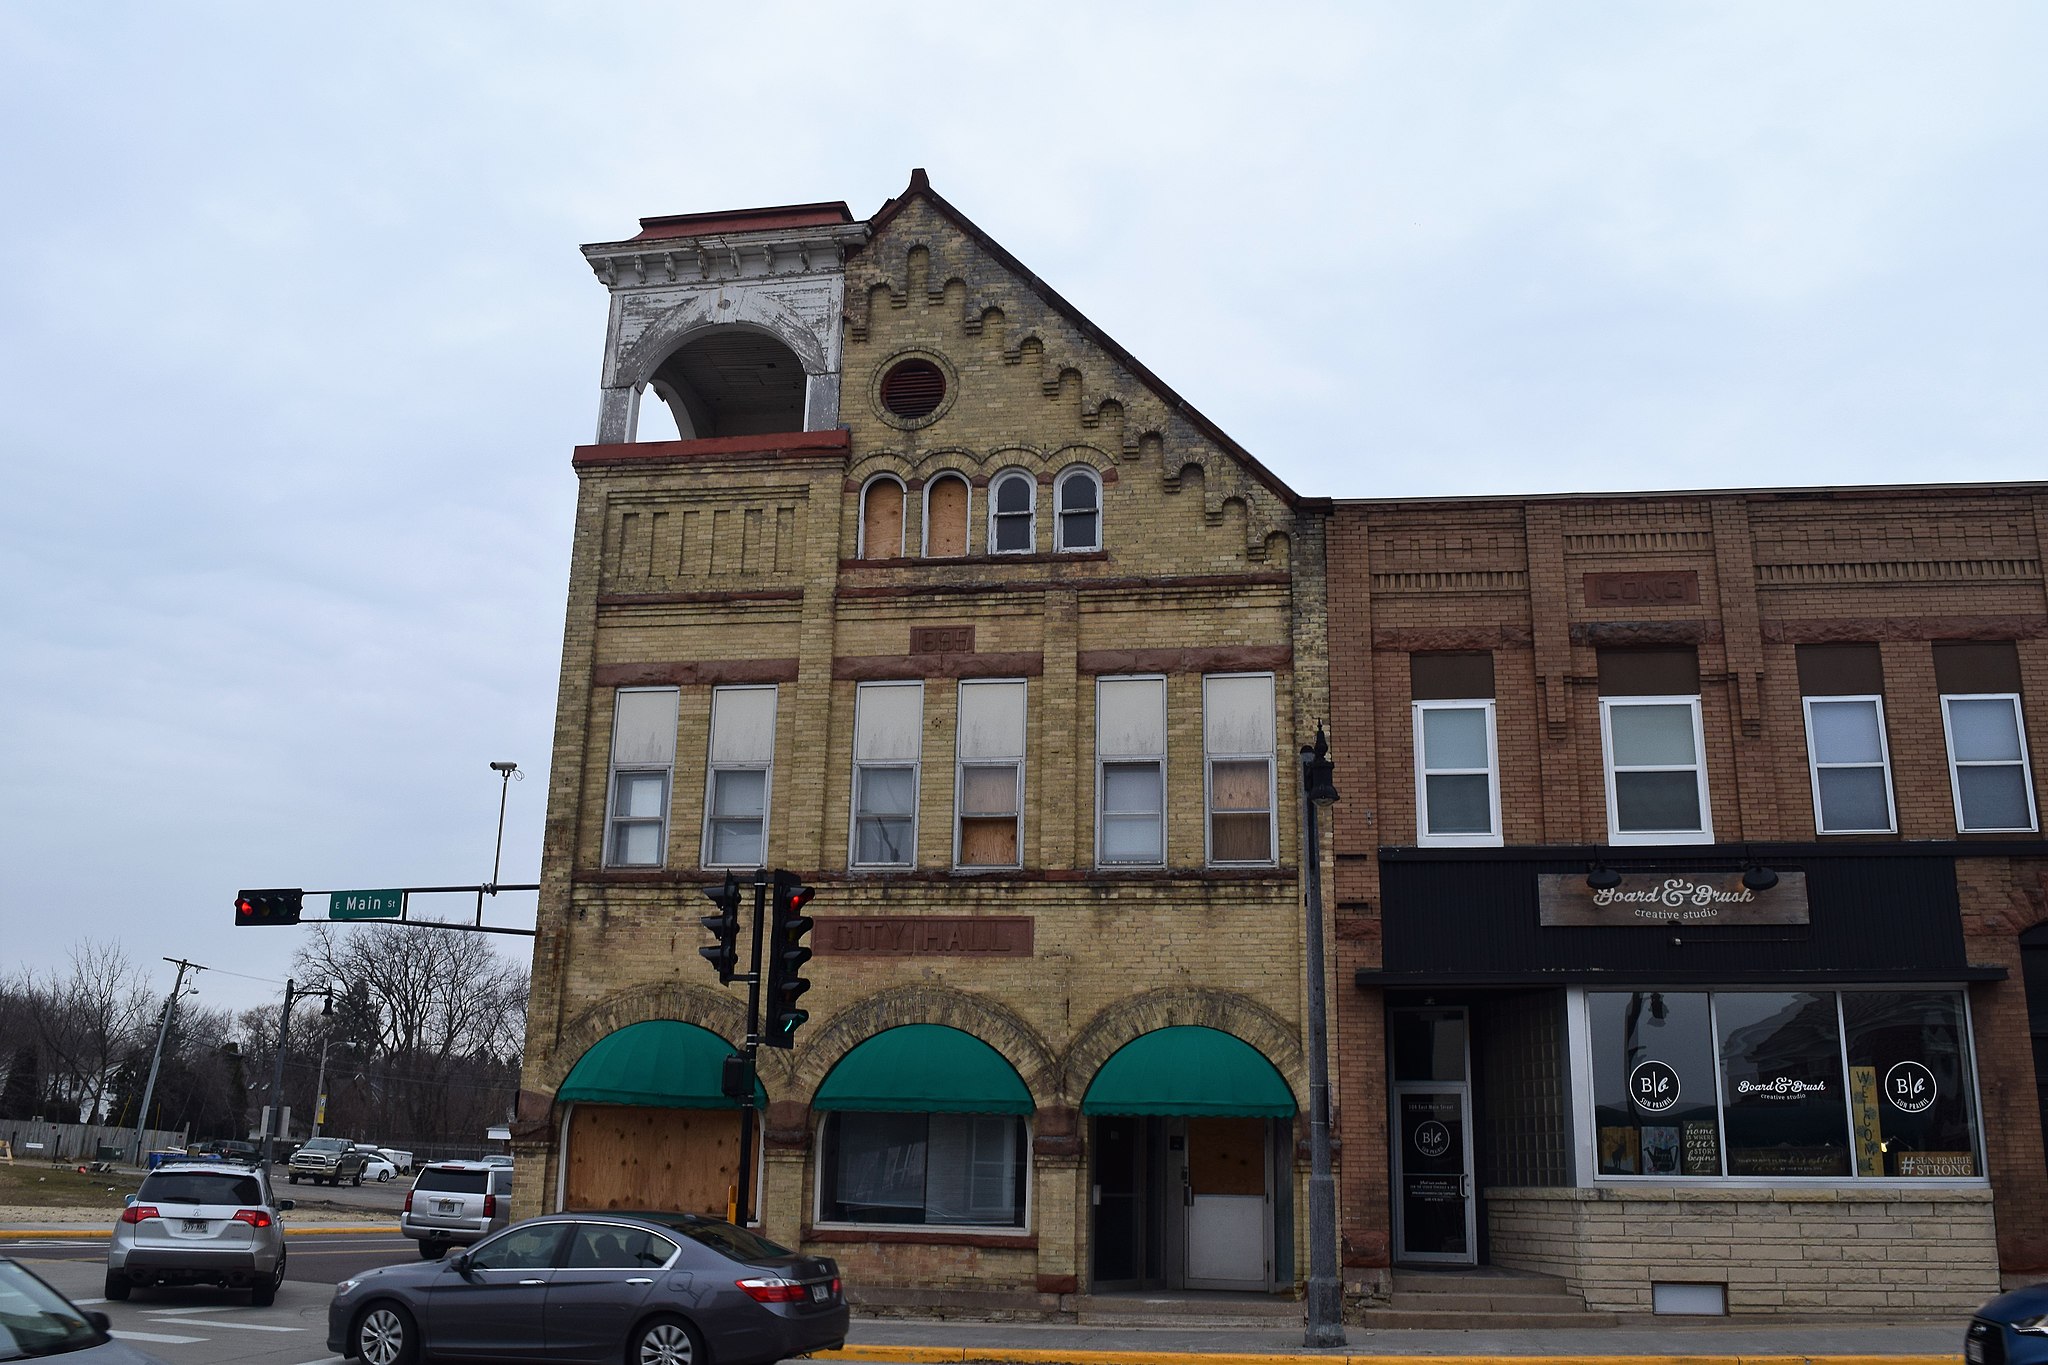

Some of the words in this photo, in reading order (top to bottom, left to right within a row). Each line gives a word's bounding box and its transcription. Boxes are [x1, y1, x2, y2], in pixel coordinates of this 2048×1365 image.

[1593, 887, 1660, 906] Board
[1692, 884, 1755, 906] Brush
[335, 901, 340, 910] E
[346, 896, 381, 911] Main
[387, 900, 396, 908] St
[1634, 908, 1680, 920] creative
[1683, 907, 1718, 920] studio
[833, 922, 906, 951] CITY
[923, 922, 1012, 951] HALL
[1738, 1080, 1774, 1093] Board
[1791, 1080, 1826, 1093] Brush
[1640, 1097, 1651, 1107] SUN
[1652, 1096, 1673, 1108] PRAIRIE
[1896, 1098, 1907, 1108] SUN
[1909, 1097, 1929, 1109] PRAIRIE
[1856, 1070, 1874, 1171] WELCOME
[1686, 1140, 1715, 1148] our
[1687, 1149, 1716, 1169] begins
[1916, 1156, 1934, 1164] SUN
[1937, 1156, 1972, 1164] PRAIRIE
[1916, 1164, 1971, 1175] STRONG
